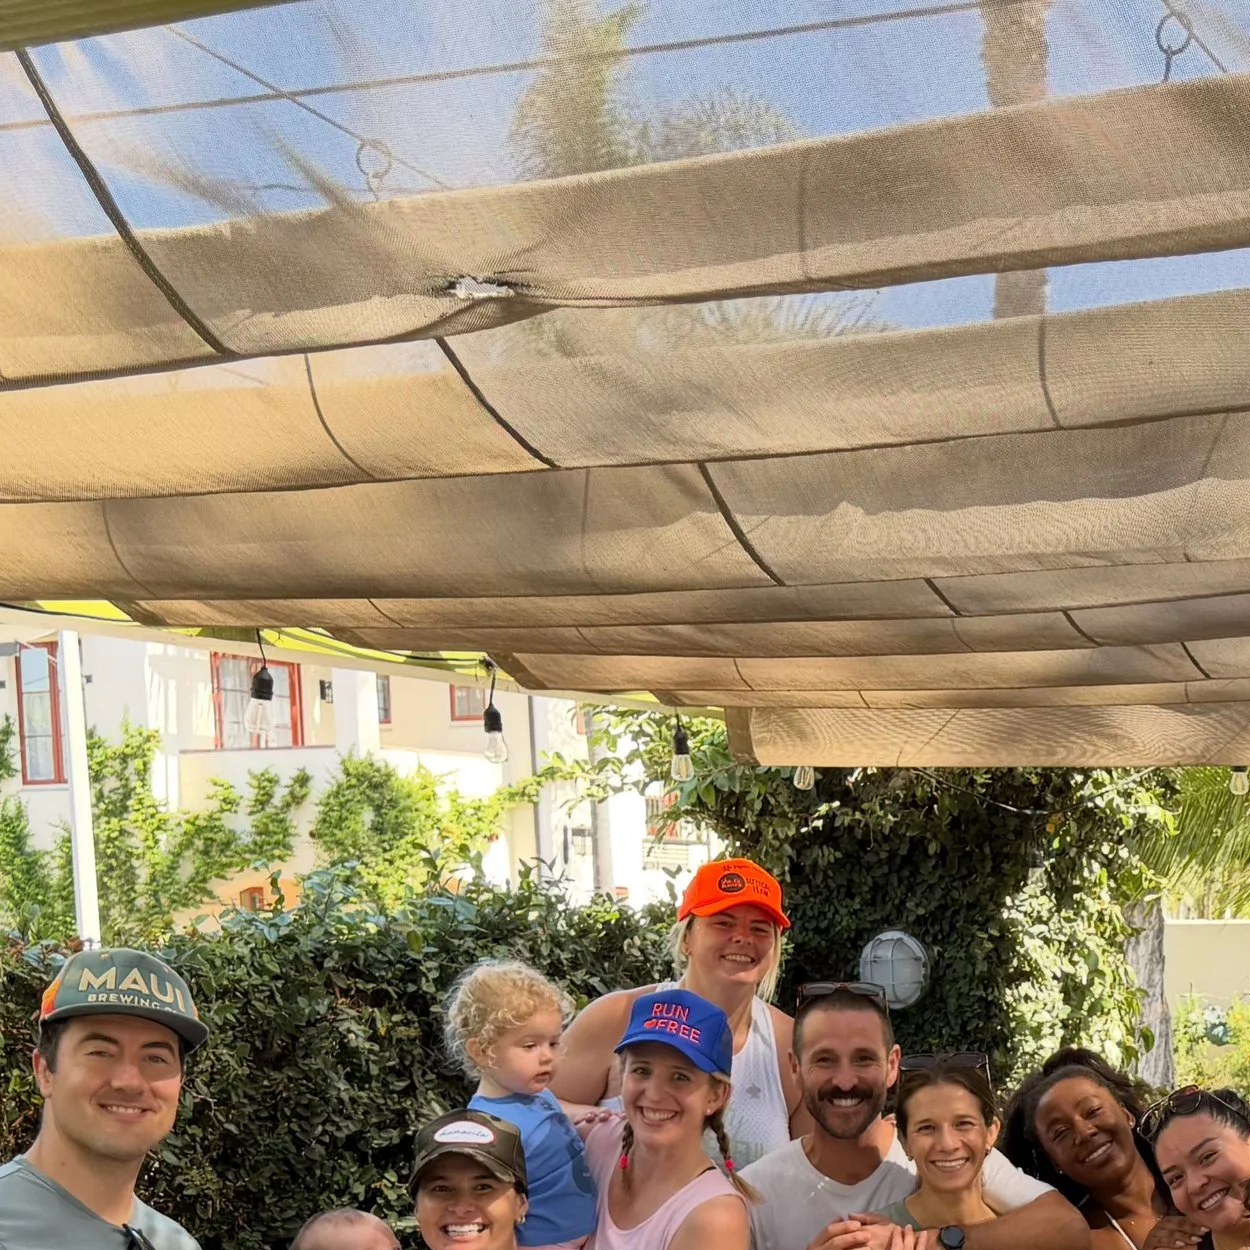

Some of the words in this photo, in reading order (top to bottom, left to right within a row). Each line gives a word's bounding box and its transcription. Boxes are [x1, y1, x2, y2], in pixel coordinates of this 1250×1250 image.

[78, 966, 186, 1013] MAUI
[88, 993, 160, 1009] BREWING
[651, 1003, 689, 1021] RUN
[656, 1019, 701, 1044] FREE
